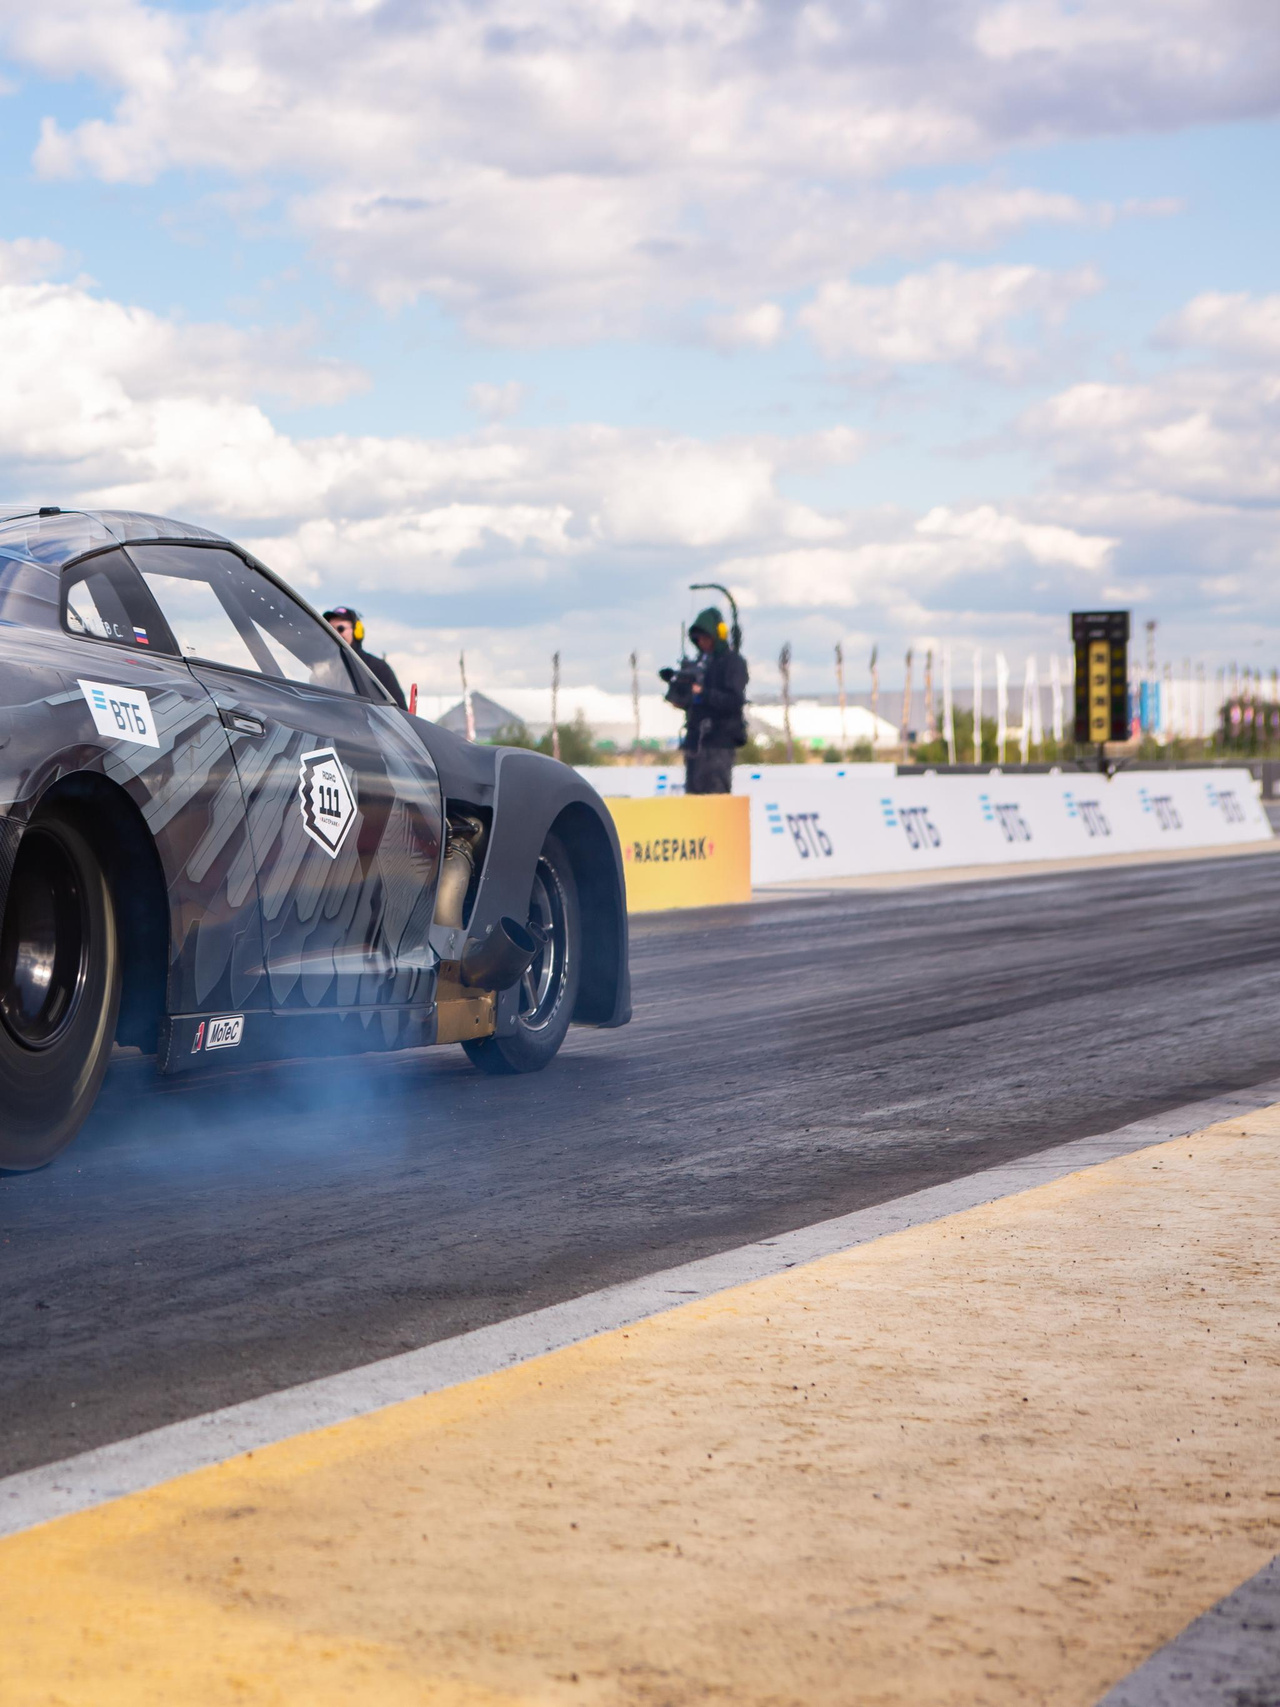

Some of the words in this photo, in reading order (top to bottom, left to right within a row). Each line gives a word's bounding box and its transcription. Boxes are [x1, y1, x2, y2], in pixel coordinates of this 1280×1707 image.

[109, 699, 147, 735] ВТБ
[319, 785, 341, 818] 111
[786, 813, 833, 858] ВТБ
[898, 807, 941, 850] ВТБ
[995, 803, 1032, 843] ВТБ
[634, 836, 707, 863] RACEPARK
[209, 1020, 240, 1044] MoTeC
